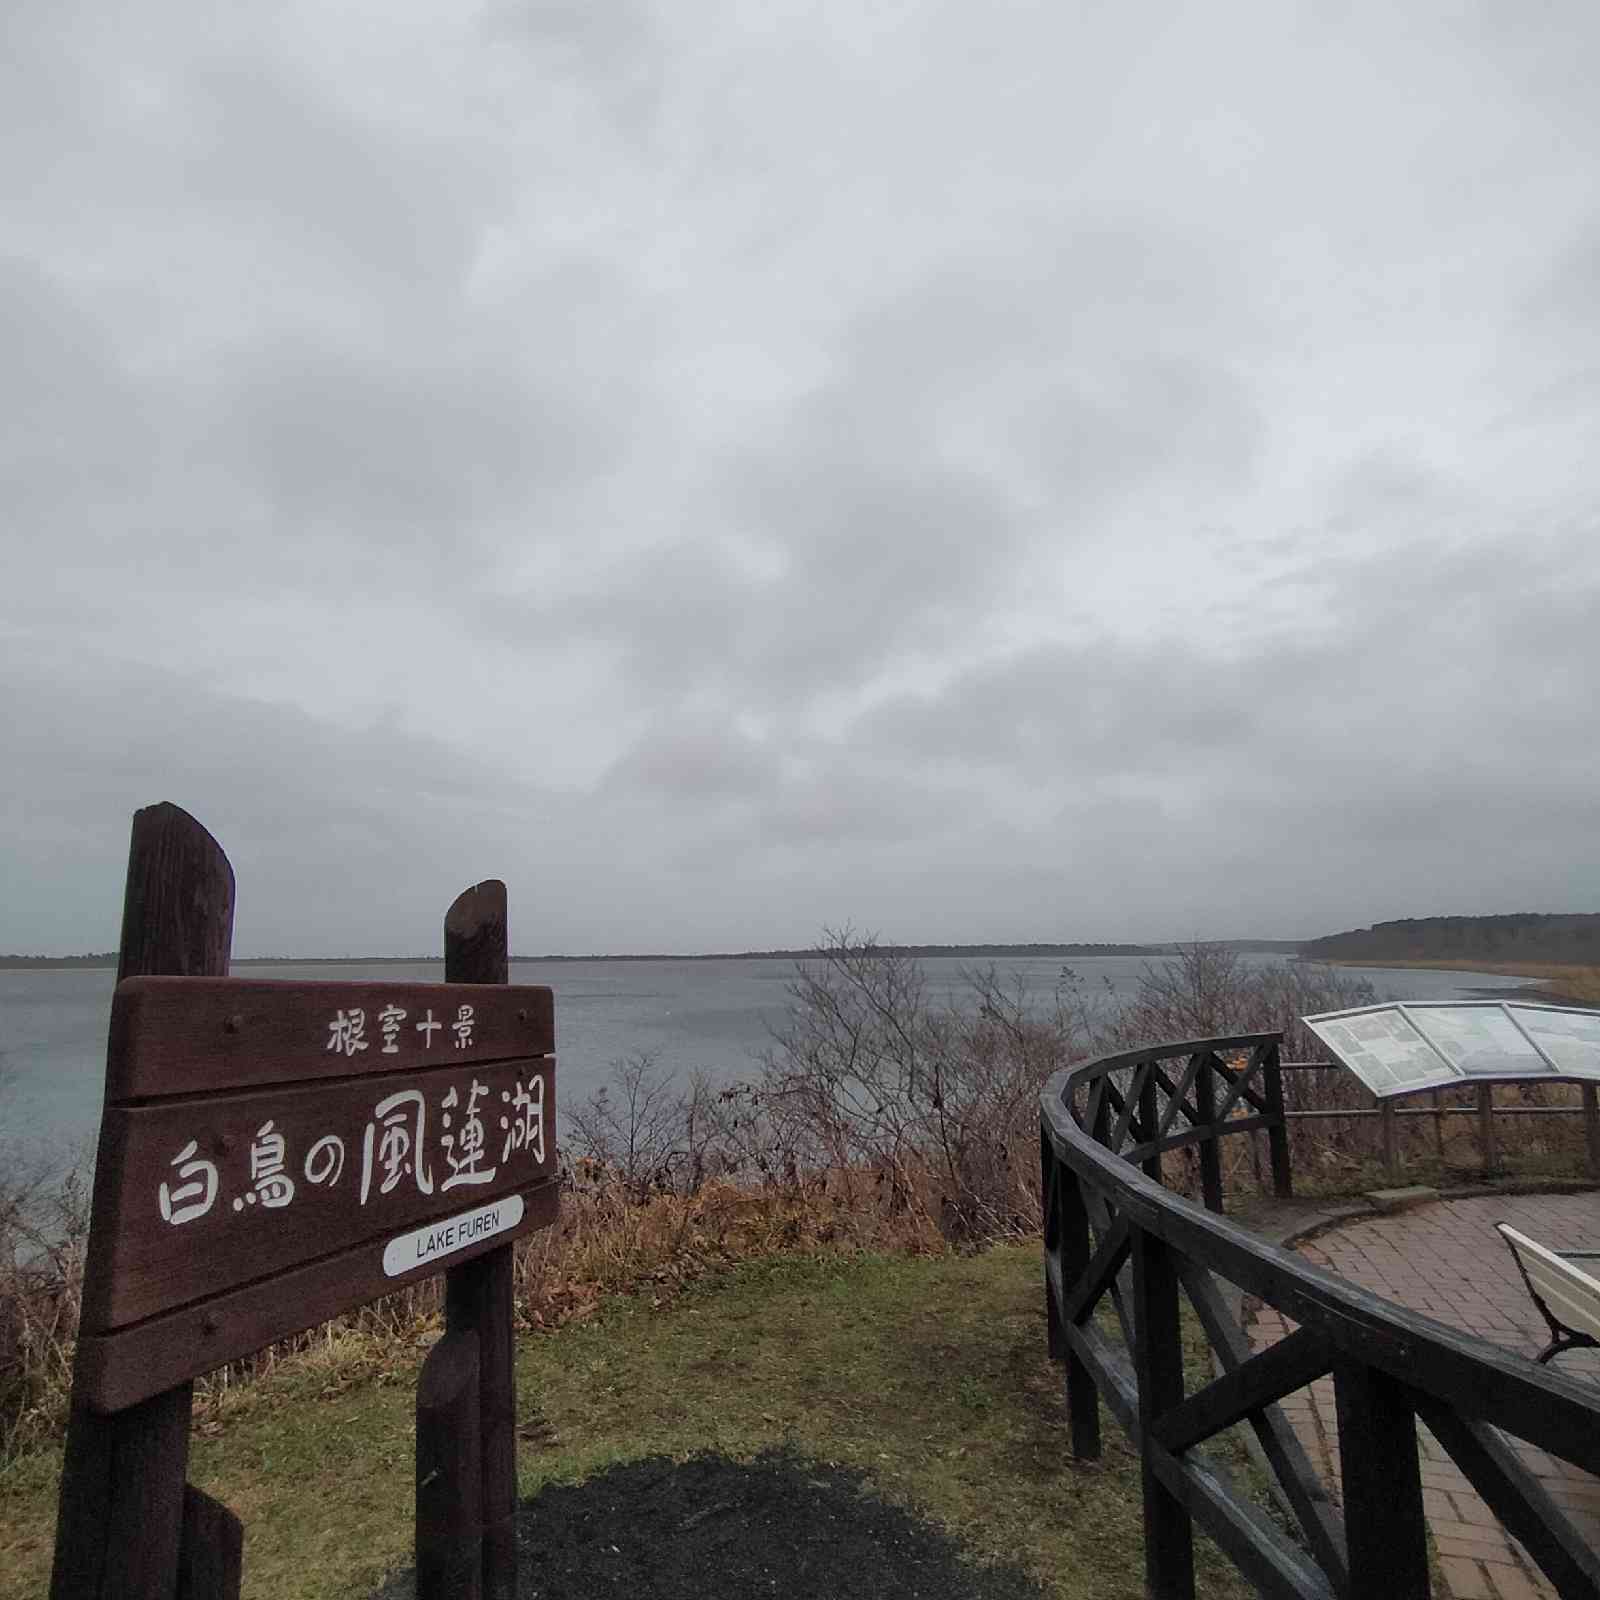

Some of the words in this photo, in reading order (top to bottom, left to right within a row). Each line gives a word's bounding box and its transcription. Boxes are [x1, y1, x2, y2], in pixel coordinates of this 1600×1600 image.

[327, 1004, 475, 1055] 根室十景
[159, 1075, 545, 1225] 白鳥の風蓮湖
[416, 1228, 455, 1258] LAKE
[458, 1210, 500, 1242] FUREN
